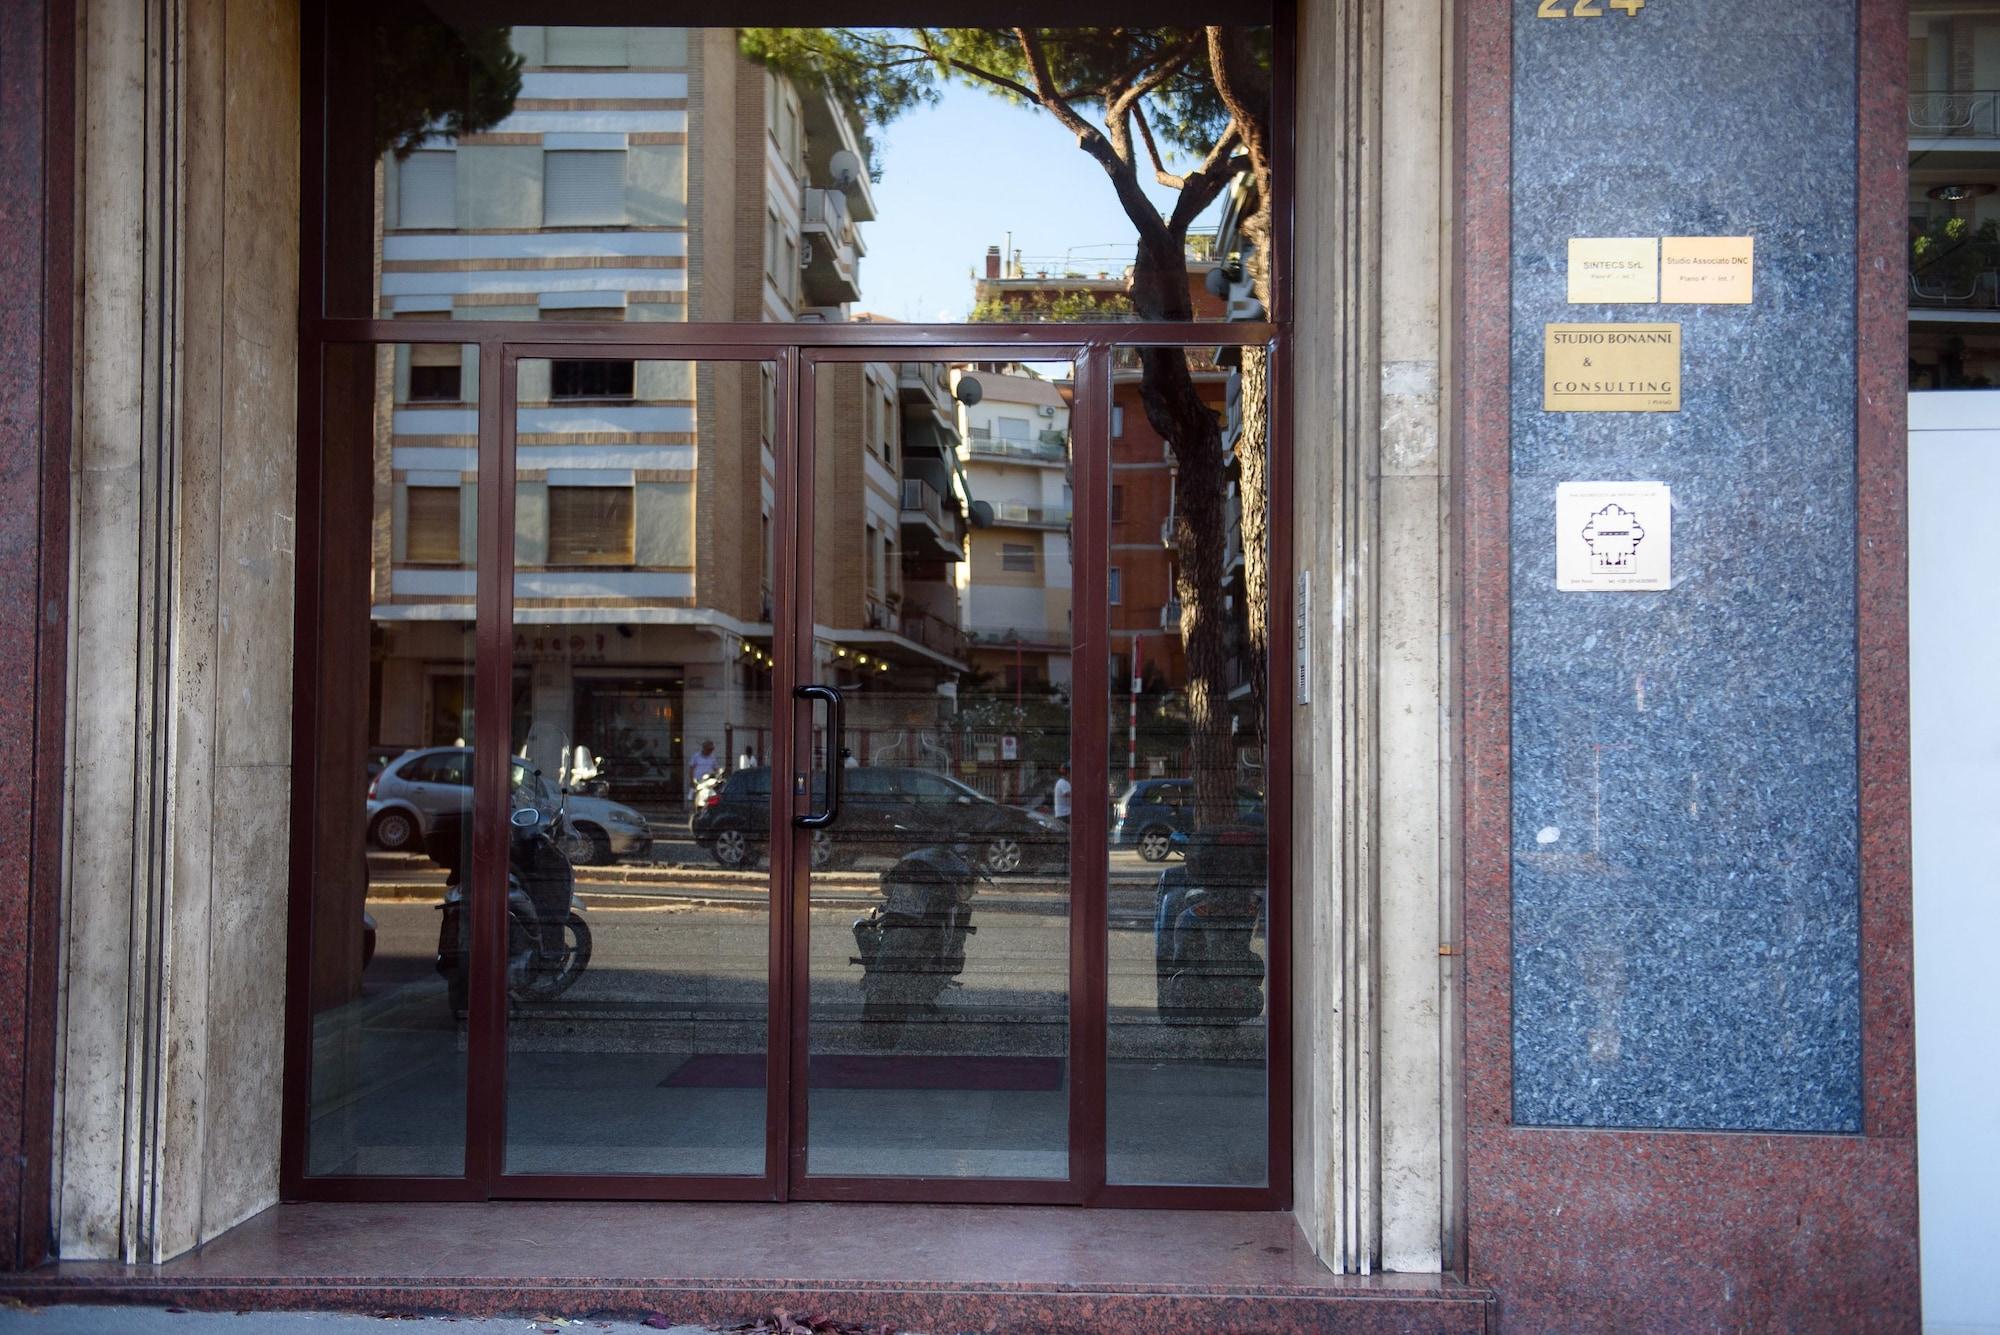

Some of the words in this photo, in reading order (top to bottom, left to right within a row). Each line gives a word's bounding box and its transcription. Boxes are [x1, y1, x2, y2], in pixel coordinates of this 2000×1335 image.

[1583, 261, 1625, 270] SINTECS
[1667, 256, 1691, 265] Studio
[1692, 256, 1730, 265] Associato
[1731, 256, 1749, 265] DNC
[1553, 333, 1604, 344] STUDIO
[1608, 333, 1672, 344] BONANNI
[1583, 357, 1592, 367] &
[1553, 381, 1672, 393] CONSULTING
